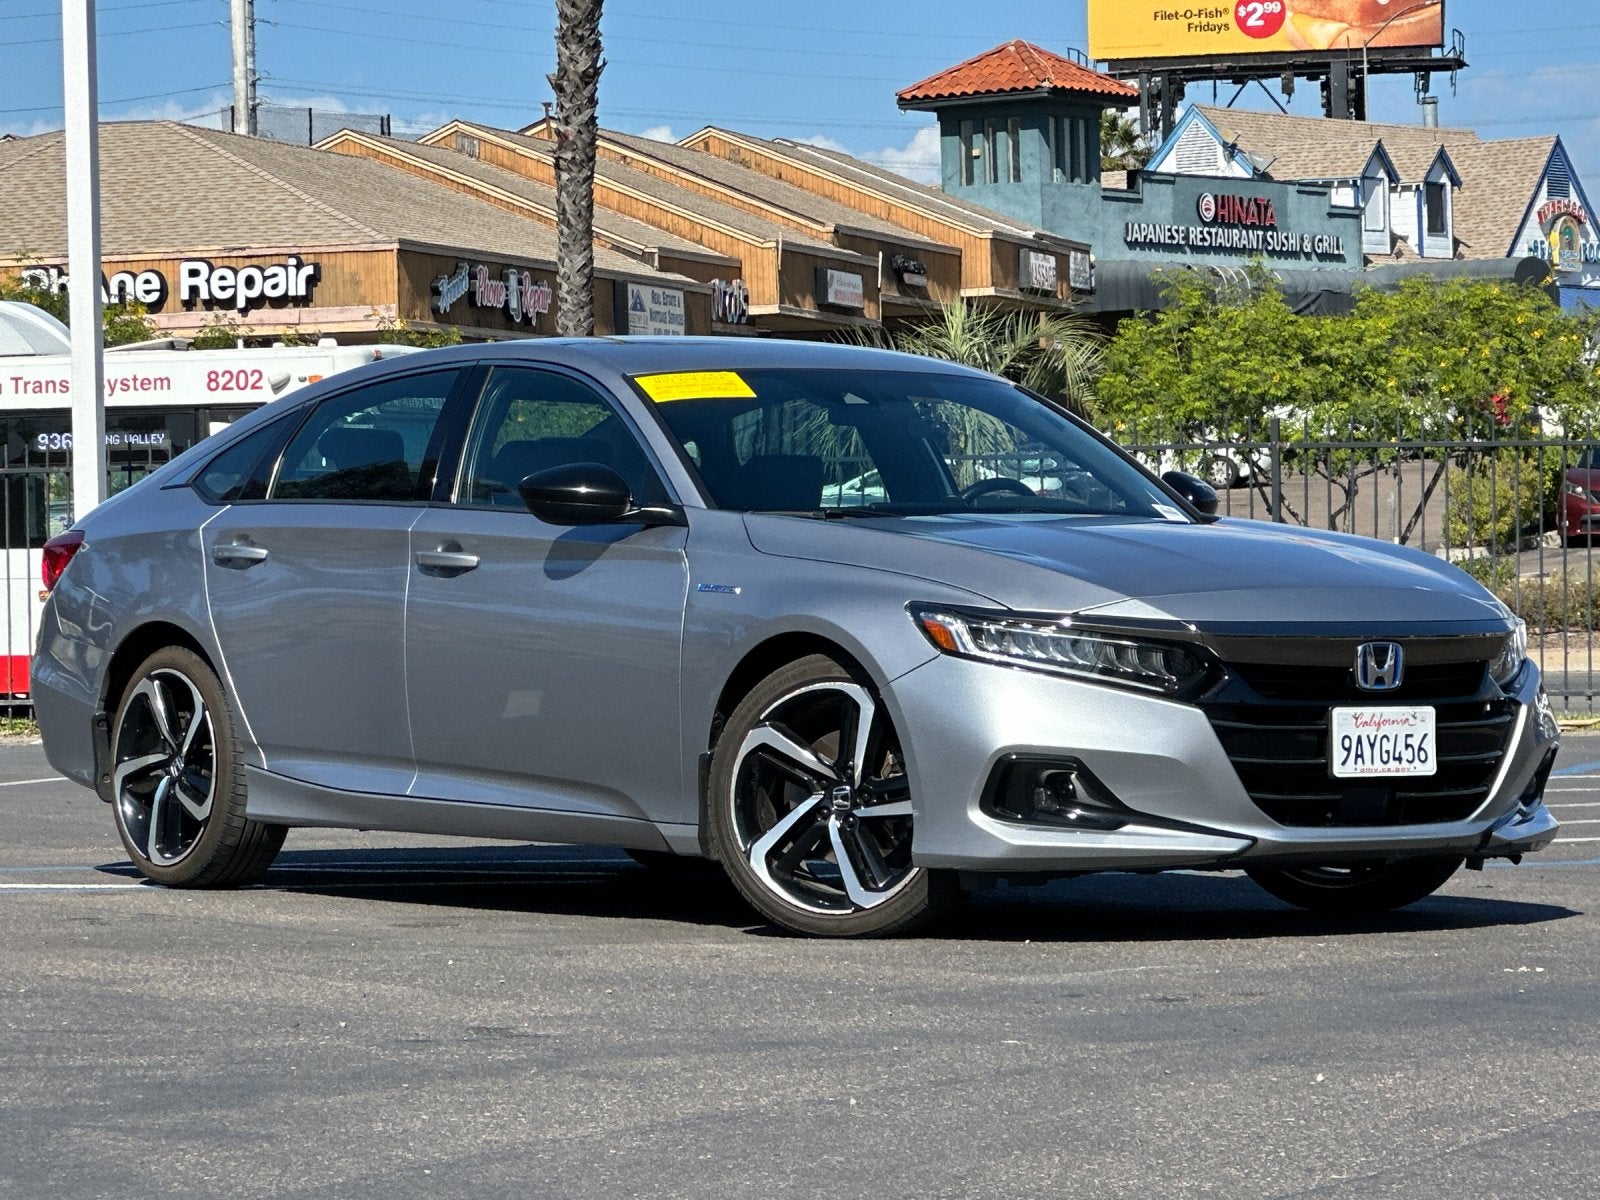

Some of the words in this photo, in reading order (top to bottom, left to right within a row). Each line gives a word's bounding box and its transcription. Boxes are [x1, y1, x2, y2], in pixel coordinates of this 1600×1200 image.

[1187, 22, 1230, 34] Fridays
[1216, 193, 1278, 227] HINATA
[1126, 222, 1186, 245] JAPANESE
[1188, 226, 1264, 250] RESTAURANT
[1266, 231, 1300, 252] SUSHI
[1302, 234, 1312, 252] &
[1314, 234, 1345, 255] GRILL
[21, 266, 164, 304] Phne
[179, 256, 316, 310] Repair
[10, 375, 70, 394] Trans
[103, 375, 171, 398] ystem
[206, 368, 264, 392] 8202
[1353, 711, 1416, 732] California
[1340, 732, 1429, 767] 9AYG456
